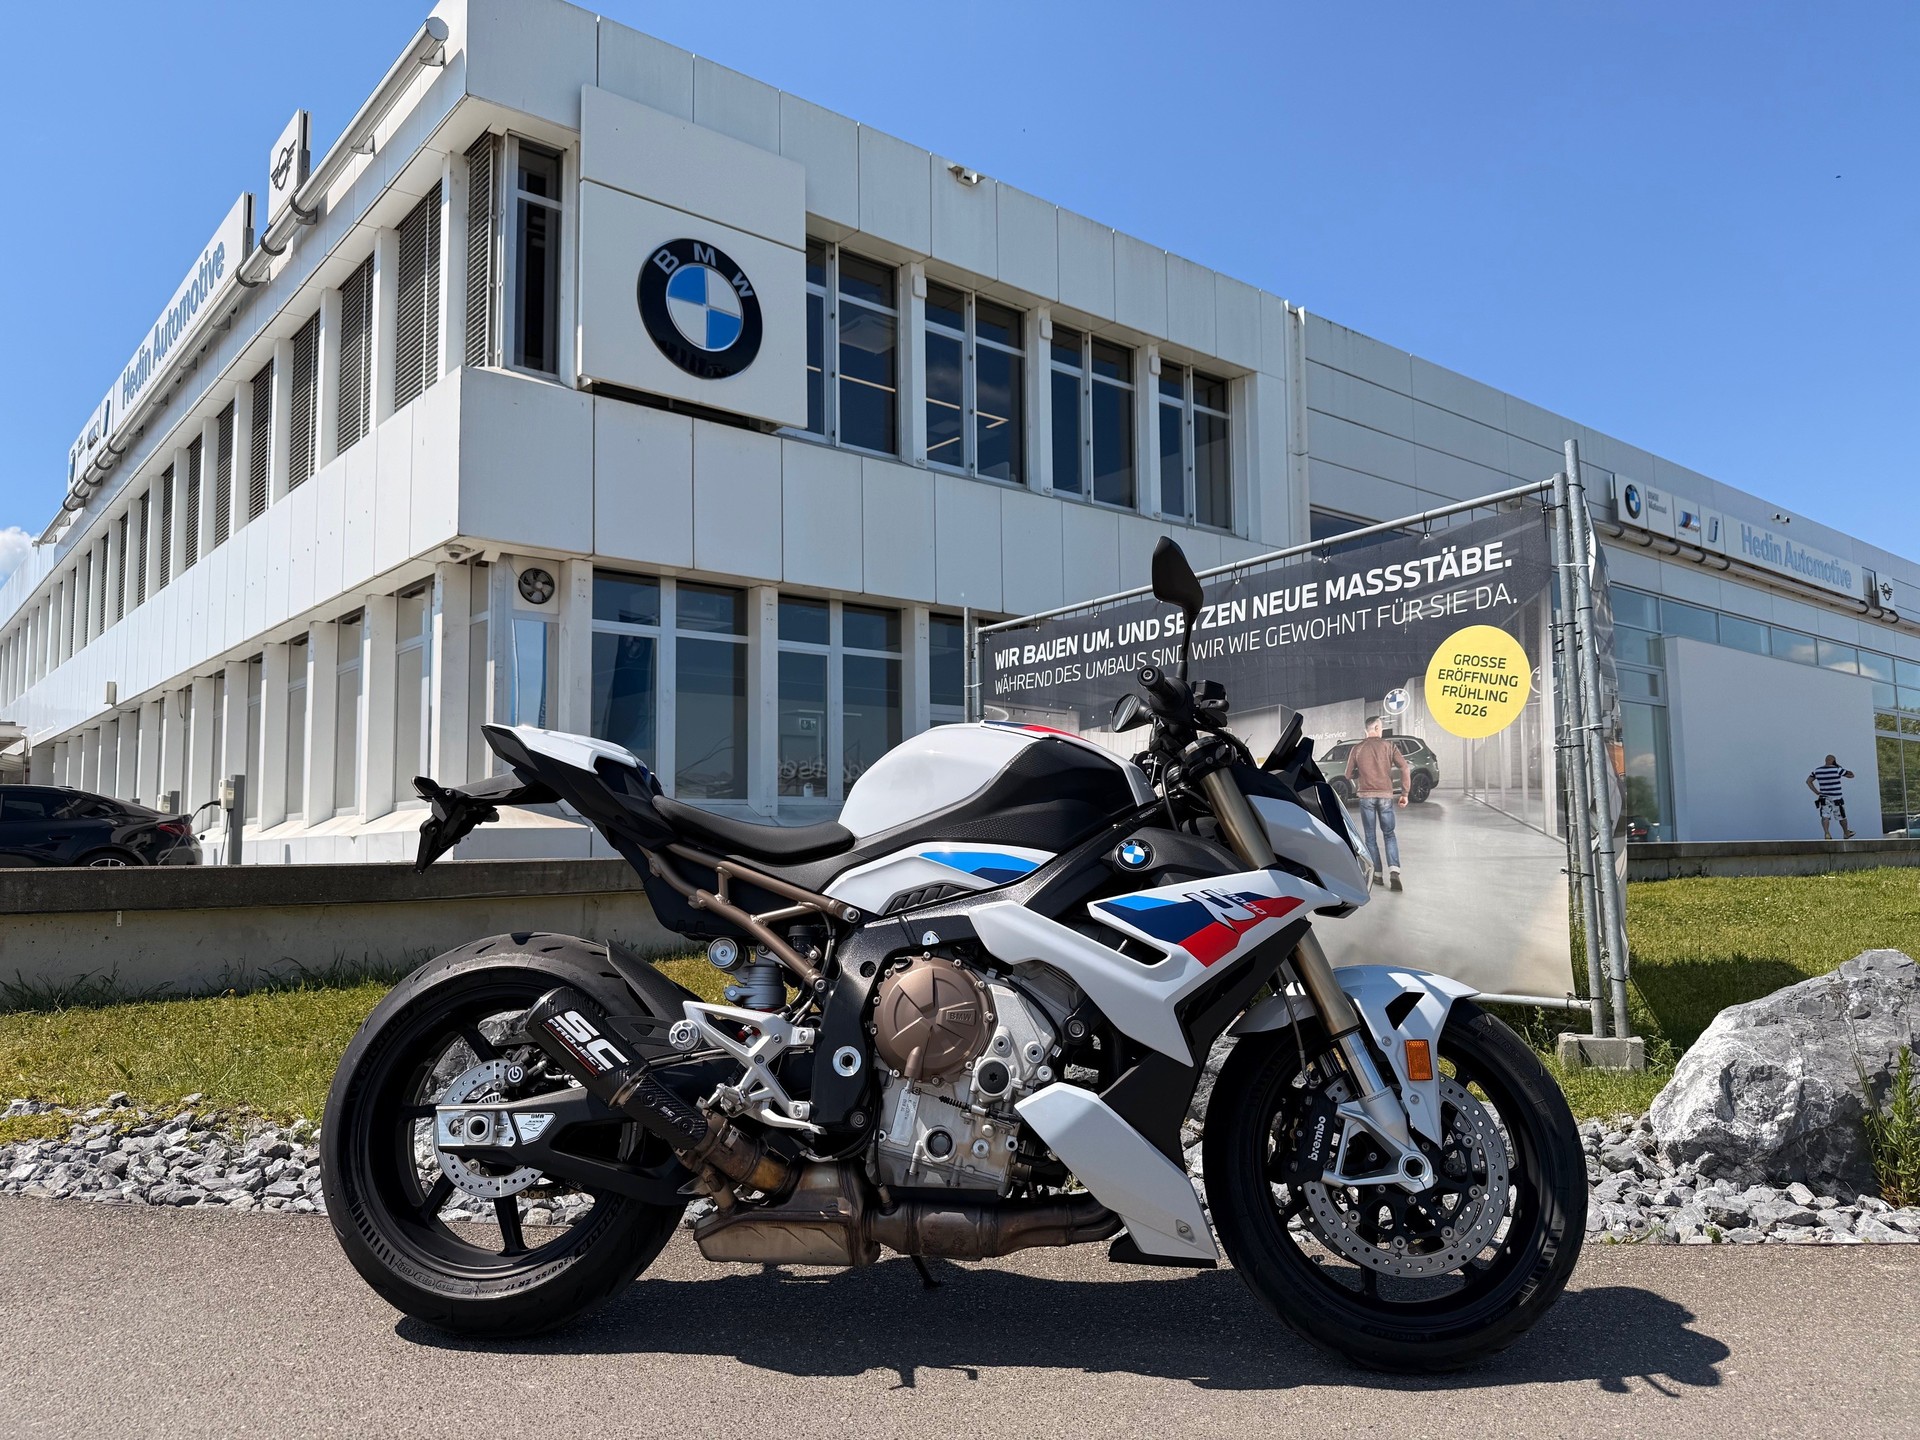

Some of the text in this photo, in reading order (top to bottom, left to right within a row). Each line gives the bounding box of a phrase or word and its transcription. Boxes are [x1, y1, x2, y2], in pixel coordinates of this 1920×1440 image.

[653, 243, 754, 298] BMW
[122, 241, 225, 410] Hedin Automotive
[1741, 523, 1852, 589] Hedin Automotive
[995, 541, 1512, 670] WIR BAUEN UM. UND SEZEN NEUE MASSSTÄBE.
[995, 669, 1053, 695] WÄHREND
[1055, 663, 1081, 683] DES
[1085, 651, 1147, 679] UMBAUS
[1191, 637, 1224, 661] WIR
[1228, 629, 1261, 654] WIE
[1265, 608, 1371, 648] GEWOHNT
[1377, 599, 1424, 628] FÜR
[1430, 587, 1468, 619] SIE
[1475, 582, 1518, 610] DA.
[1453, 653, 1507, 669] GROSSE
[1437, 667, 1519, 687] ERÖFFNUNG
[1441, 683, 1508, 703] FRÜHLING
[1455, 702, 1488, 717] 2026
[1120, 840, 1150, 852] BMW
[554, 1010, 629, 1070] SC
[950, 1012, 973, 1022] BMW
[547, 1018, 607, 1072] PROJECT
[1307, 1115, 1327, 1162] brembo
